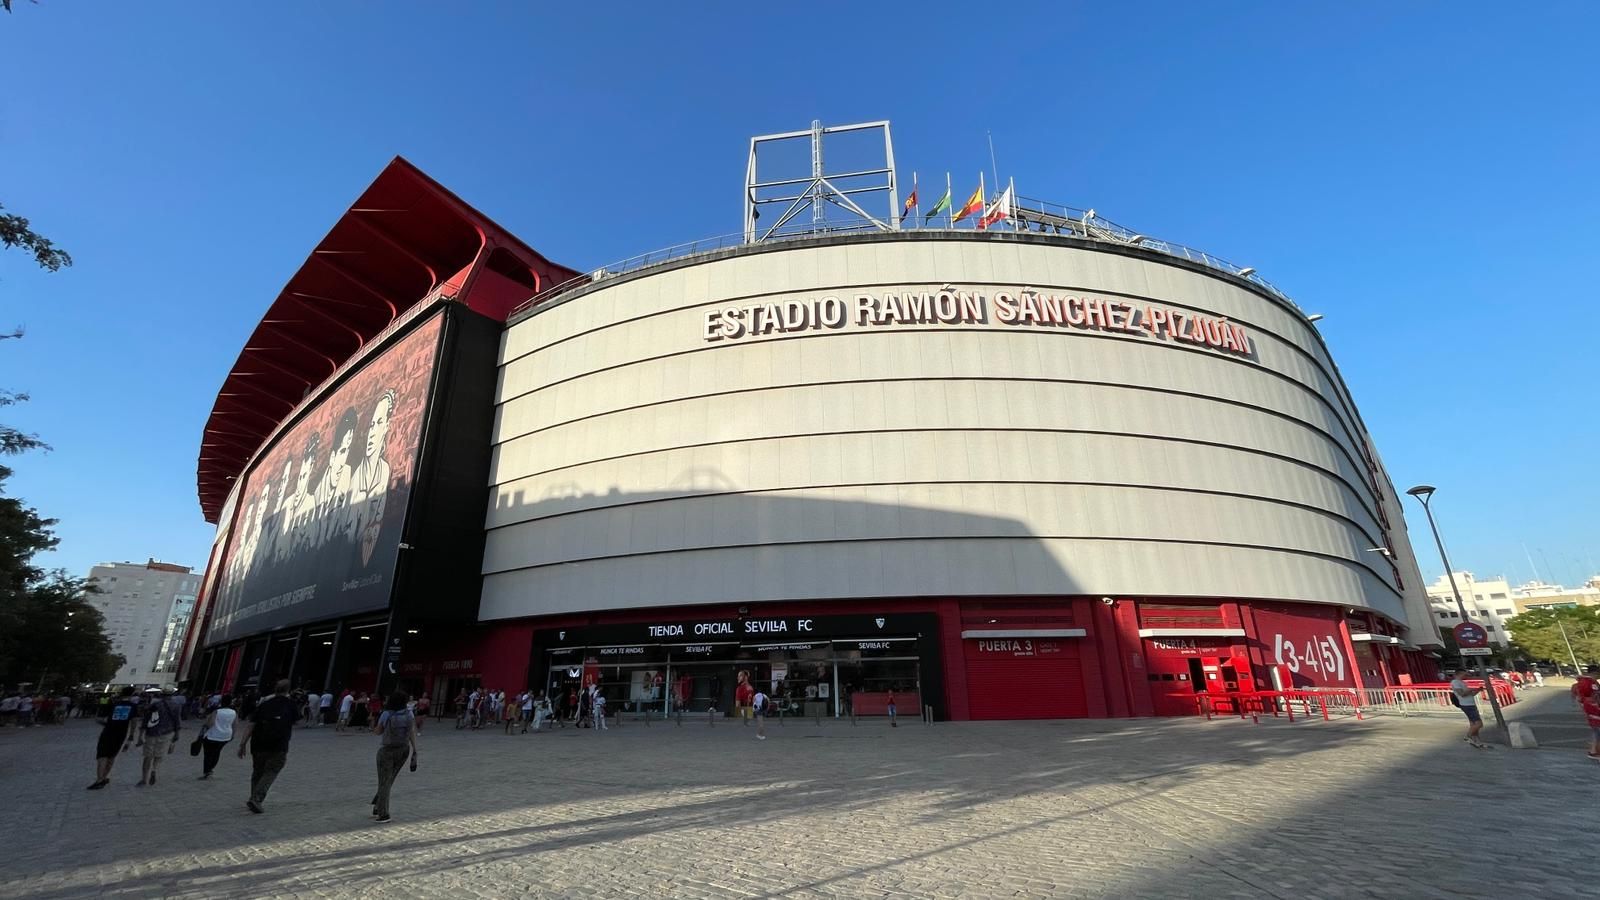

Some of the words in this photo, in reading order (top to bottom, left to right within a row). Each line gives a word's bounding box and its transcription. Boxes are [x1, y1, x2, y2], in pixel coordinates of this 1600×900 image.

[703, 296, 843, 341] ESTADIO
[854, 284, 985, 323] RAMÓN
[648, 624, 684, 637] TIENDA
[694, 622, 734, 635] OFICIAL
[744, 620, 788, 633] SEVILLA
[797, 619, 813, 632] FC
[978, 640, 1021, 652] PUERTA
[1025, 640, 1032, 651] 3
[1153, 639, 1187, 649] PUERTA
[1189, 639, 1196, 650] 4
